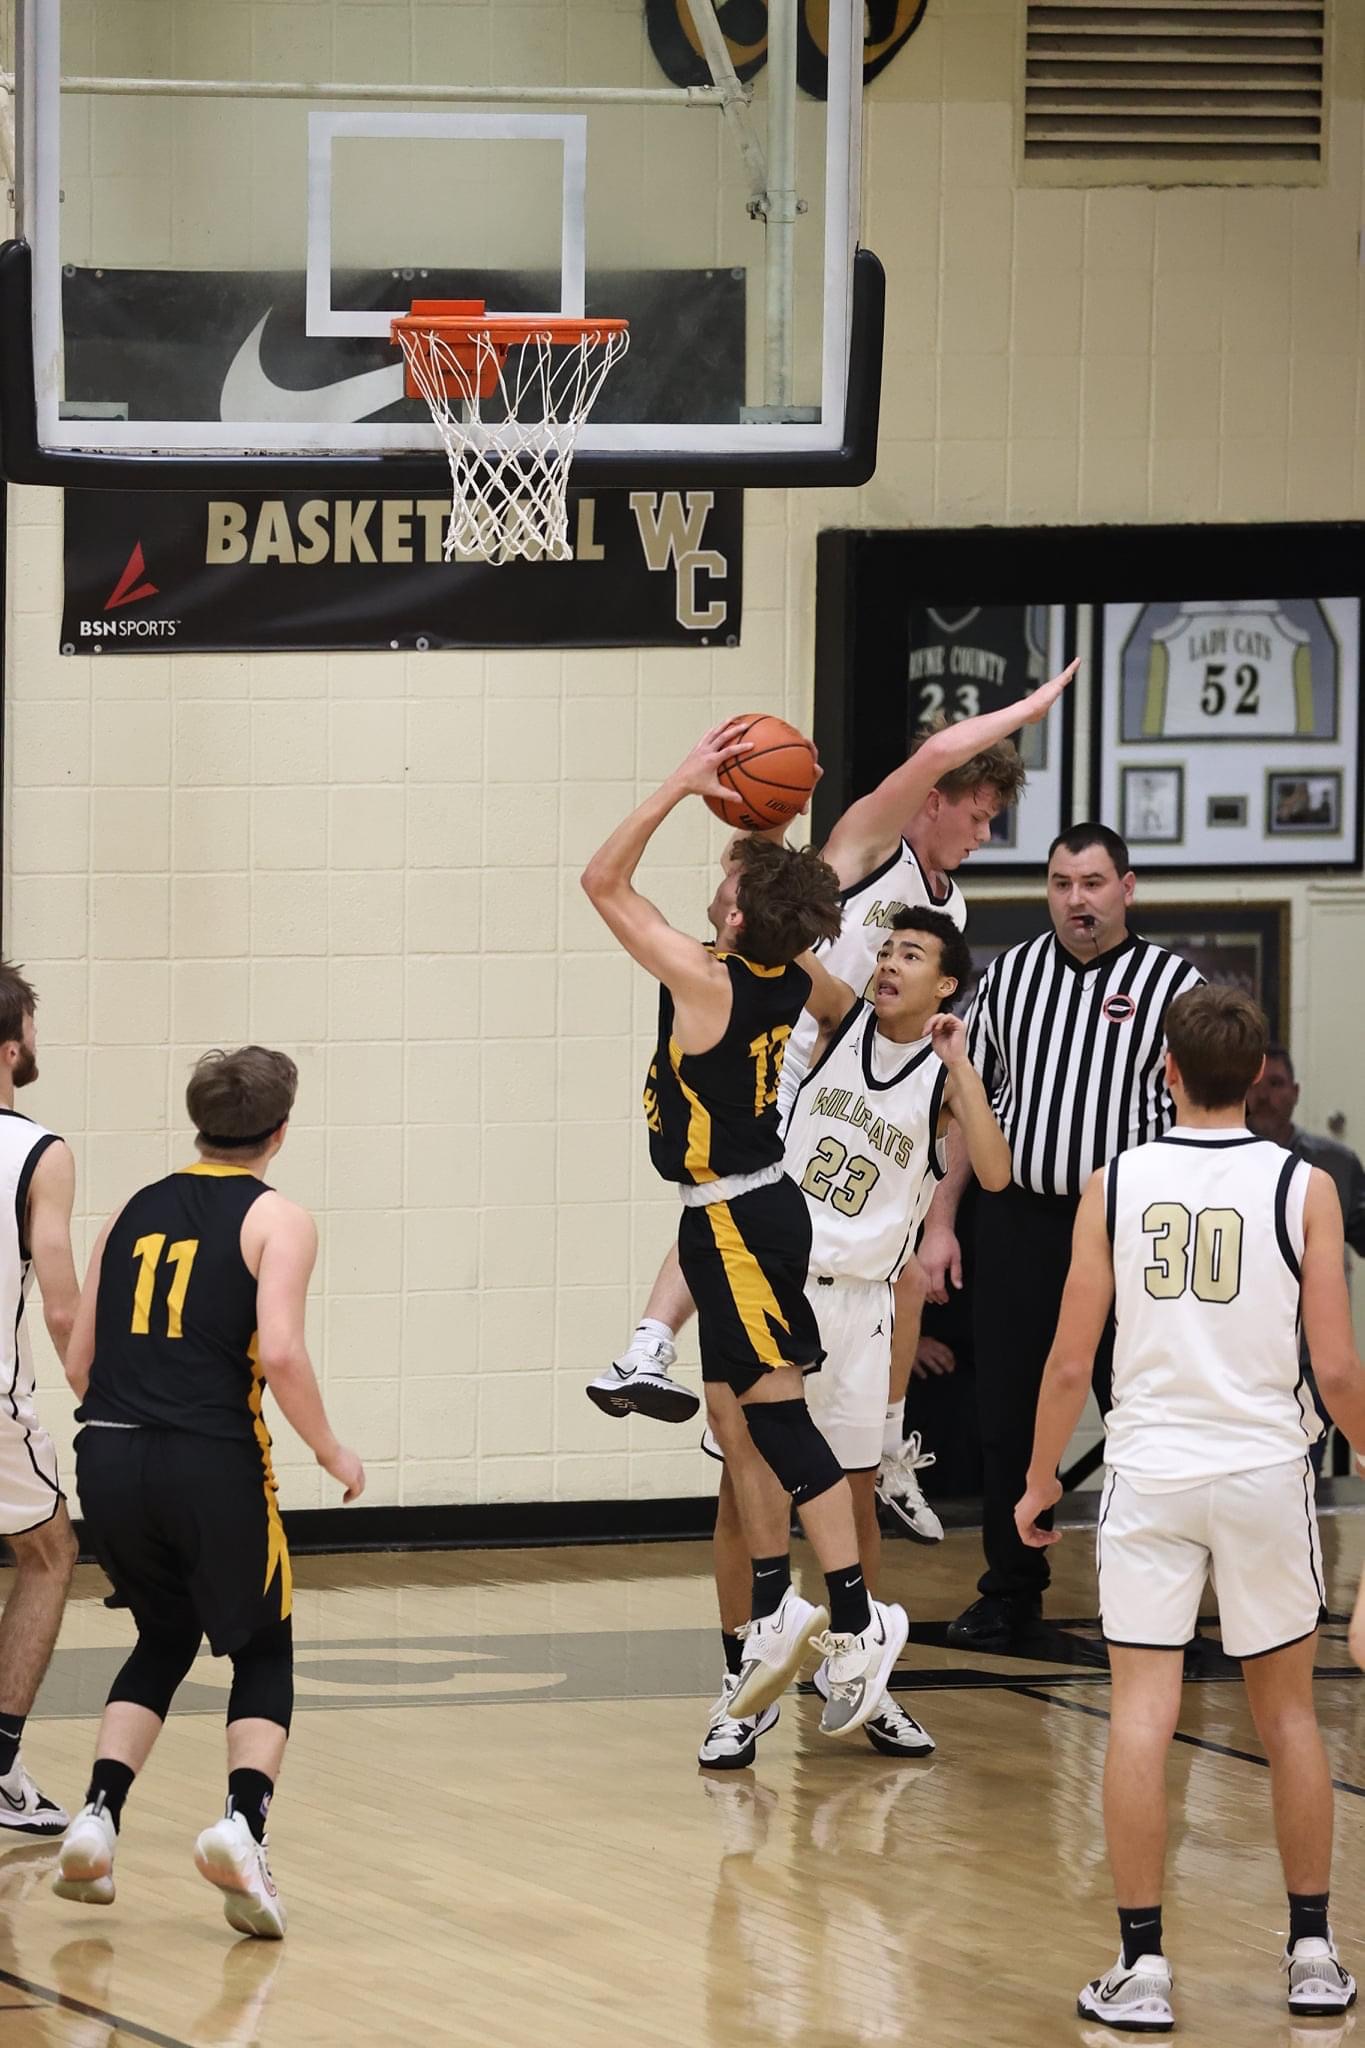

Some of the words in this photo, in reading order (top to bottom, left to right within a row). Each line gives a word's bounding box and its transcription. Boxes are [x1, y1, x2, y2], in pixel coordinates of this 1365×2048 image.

[80, 621, 117, 637] BSN
[119, 620, 176, 637] SPORTS
[1188, 628, 1228, 662] LADY
[1233, 628, 1272, 662] CATS
[950, 645, 1007, 686] COUNTY
[918, 683, 980, 722] 23
[1201, 663, 1260, 716] 52
[801, 1136, 880, 1218] 23
[1142, 1202, 1244, 1304] 30
[131, 1232, 200, 1338] 11
